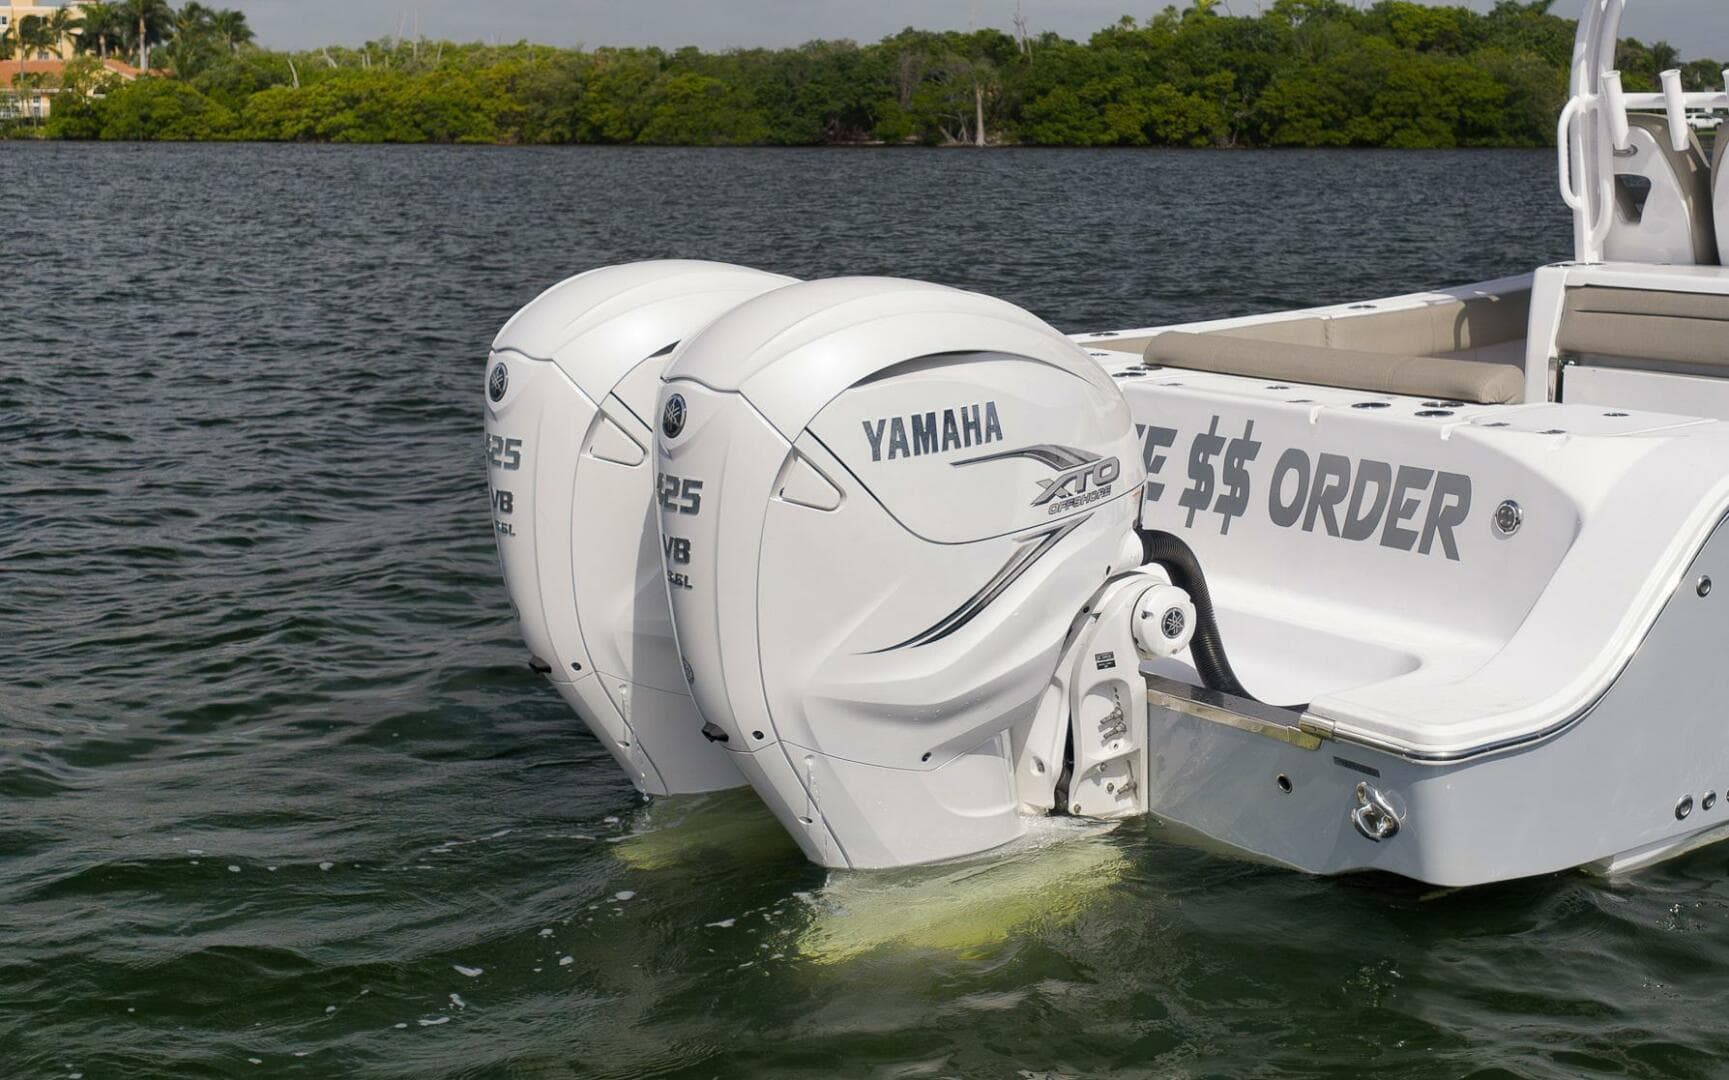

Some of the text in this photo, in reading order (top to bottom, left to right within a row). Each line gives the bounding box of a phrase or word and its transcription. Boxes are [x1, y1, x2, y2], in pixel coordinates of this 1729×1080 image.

[485, 433, 522, 471] 25
[862, 401, 1003, 462] YAMAHA
[1030, 456, 1120, 507] XTO
[1048, 484, 1112, 515] OFFSHORE
[1134, 423, 1178, 502] E
[1268, 448, 1472, 561] ORDER
[662, 533, 691, 564] V8
